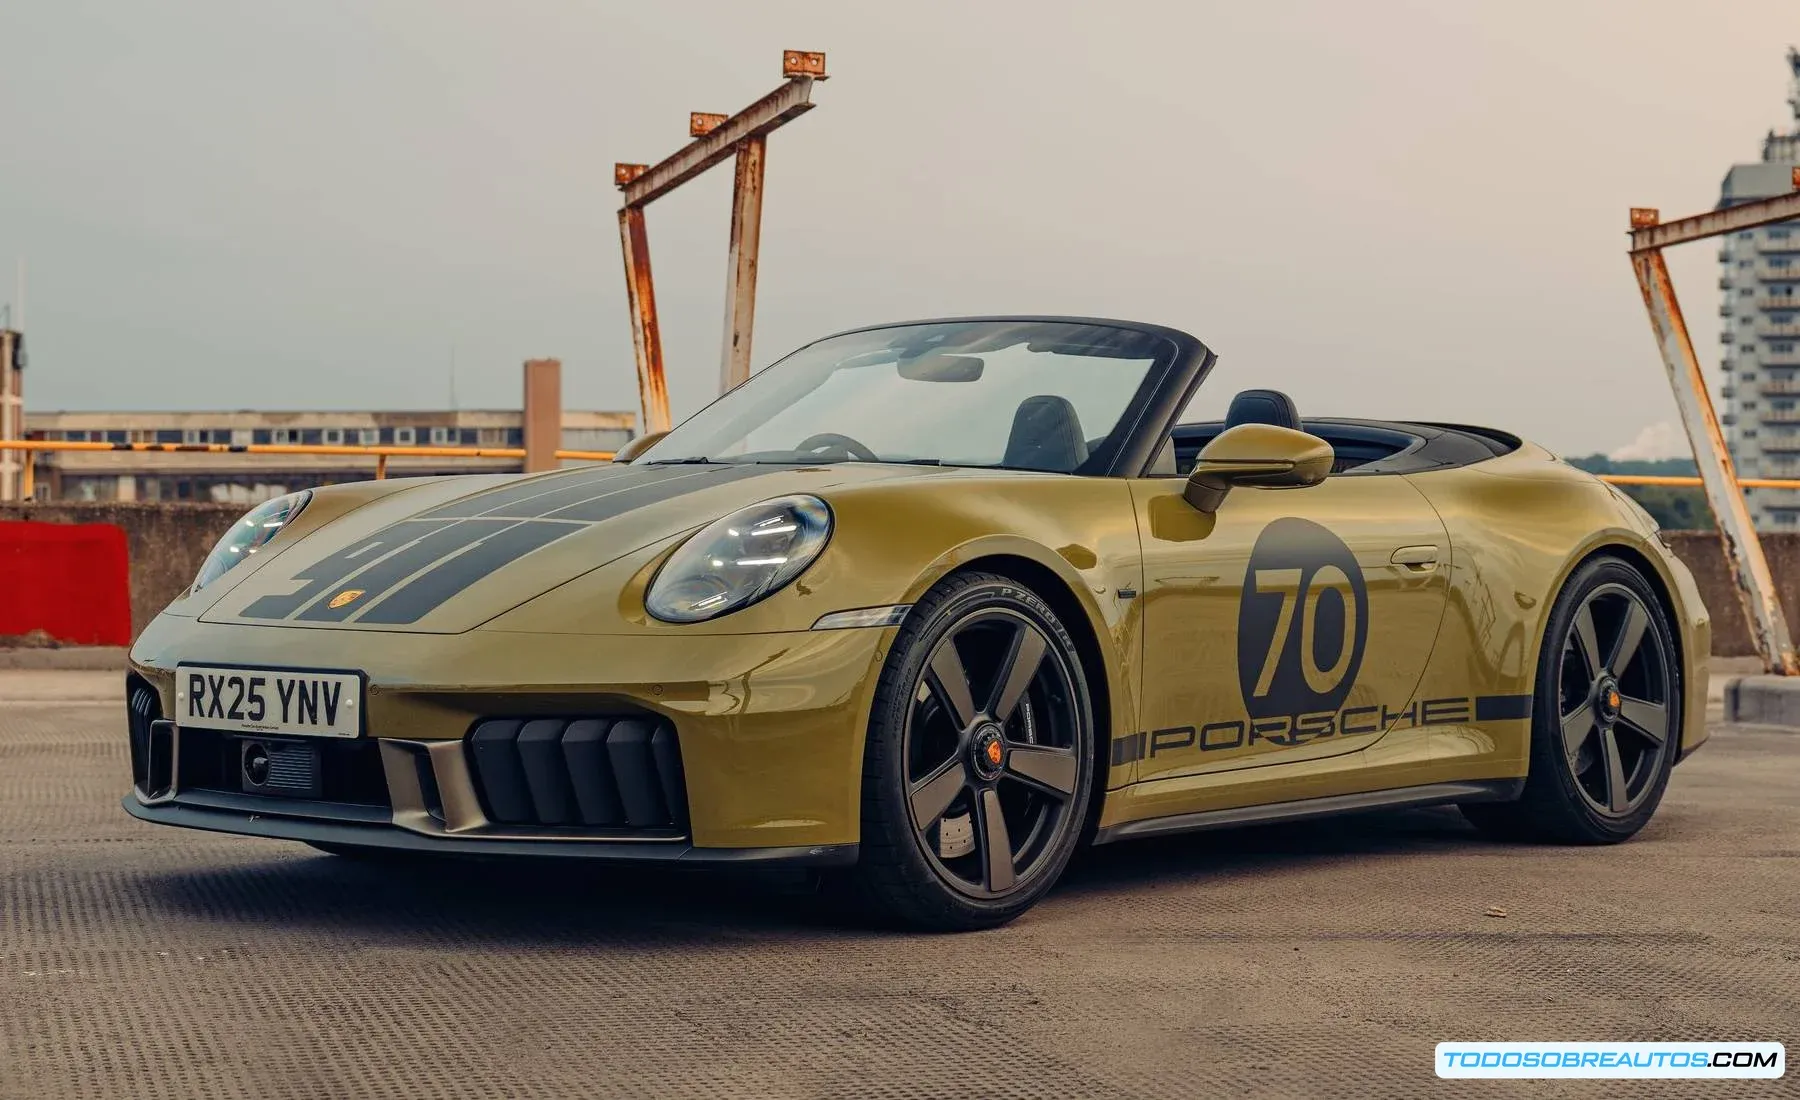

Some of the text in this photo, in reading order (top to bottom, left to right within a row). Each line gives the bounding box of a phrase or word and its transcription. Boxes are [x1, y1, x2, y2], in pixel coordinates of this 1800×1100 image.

[1015, 591, 1056, 624] ZERO
[1252, 565, 1356, 698] 70
[189, 674, 341, 726] RX25 YNV
[1025, 703, 1034, 744] PORSC
[1150, 697, 1469, 759] PORSCHE
